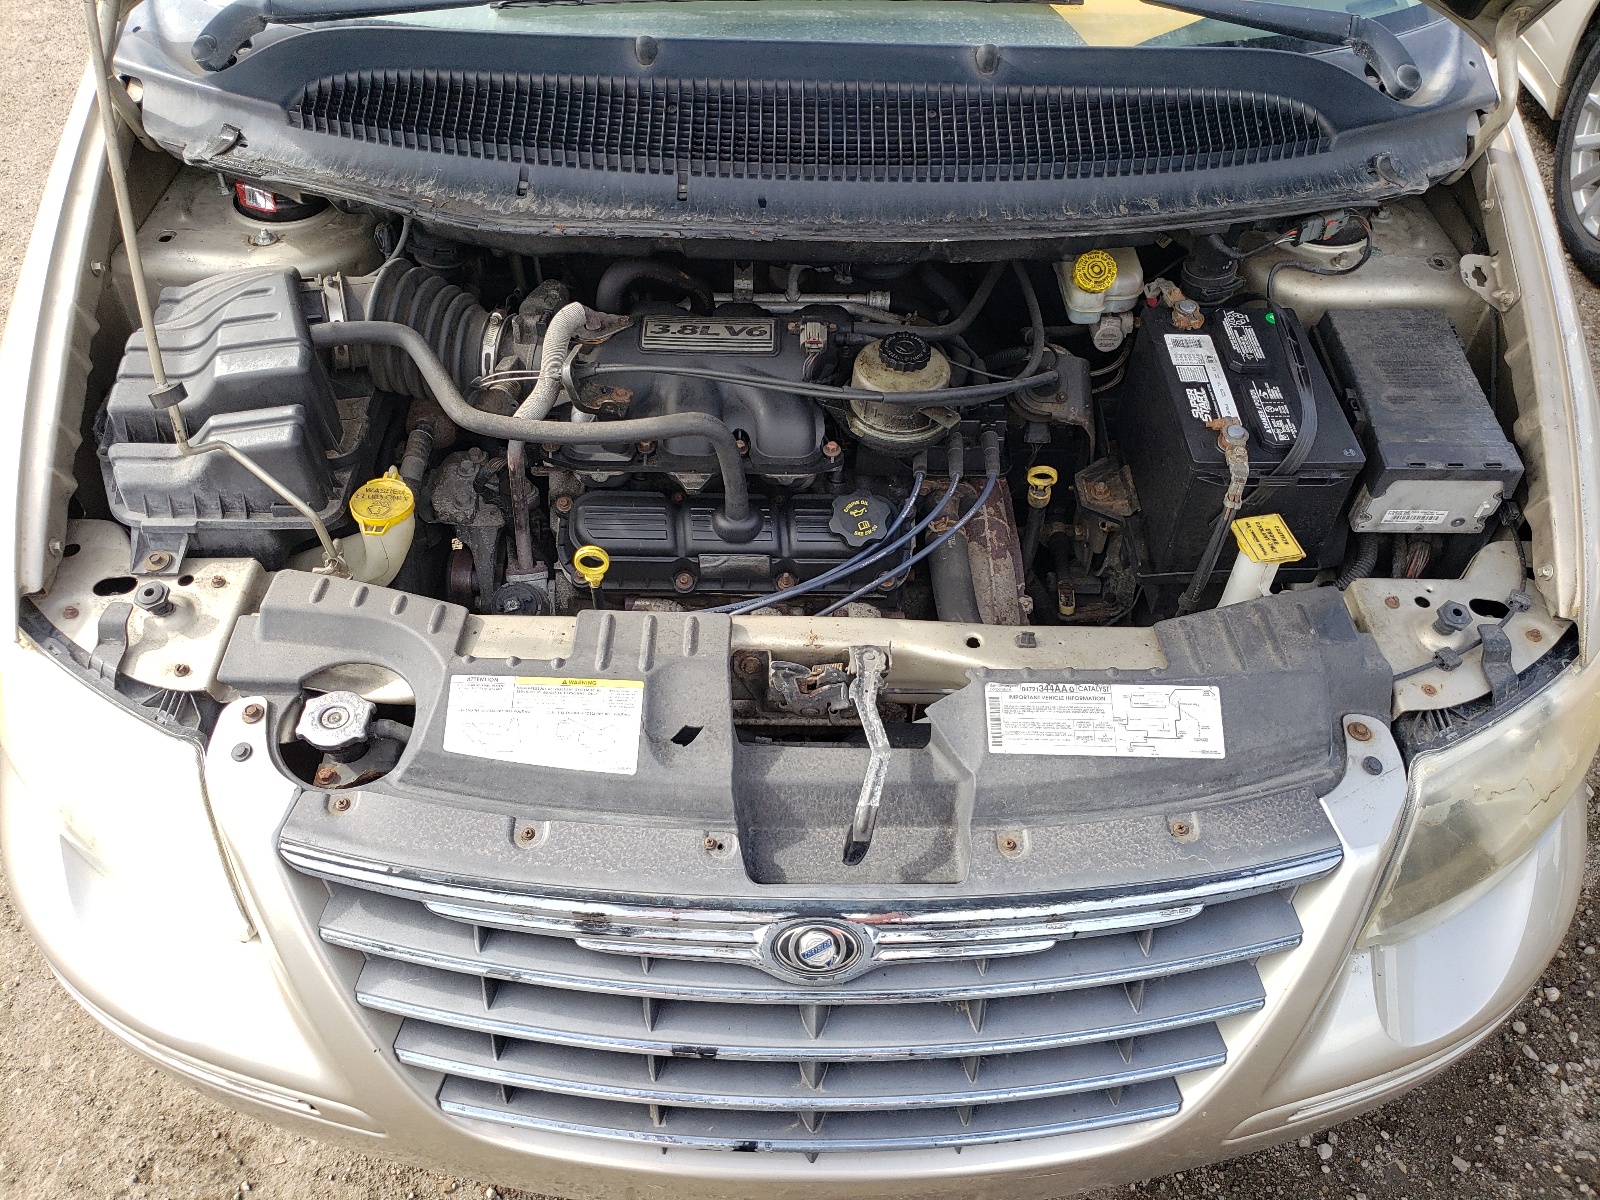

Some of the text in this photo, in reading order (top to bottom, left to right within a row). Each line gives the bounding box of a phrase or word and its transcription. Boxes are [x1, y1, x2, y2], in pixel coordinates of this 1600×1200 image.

[650, 324, 768, 337] 3.8L V6
[1185, 388, 1201, 418] SUPER
[1195, 388, 1212, 422] START
[365, 487, 406, 496] WASHER
